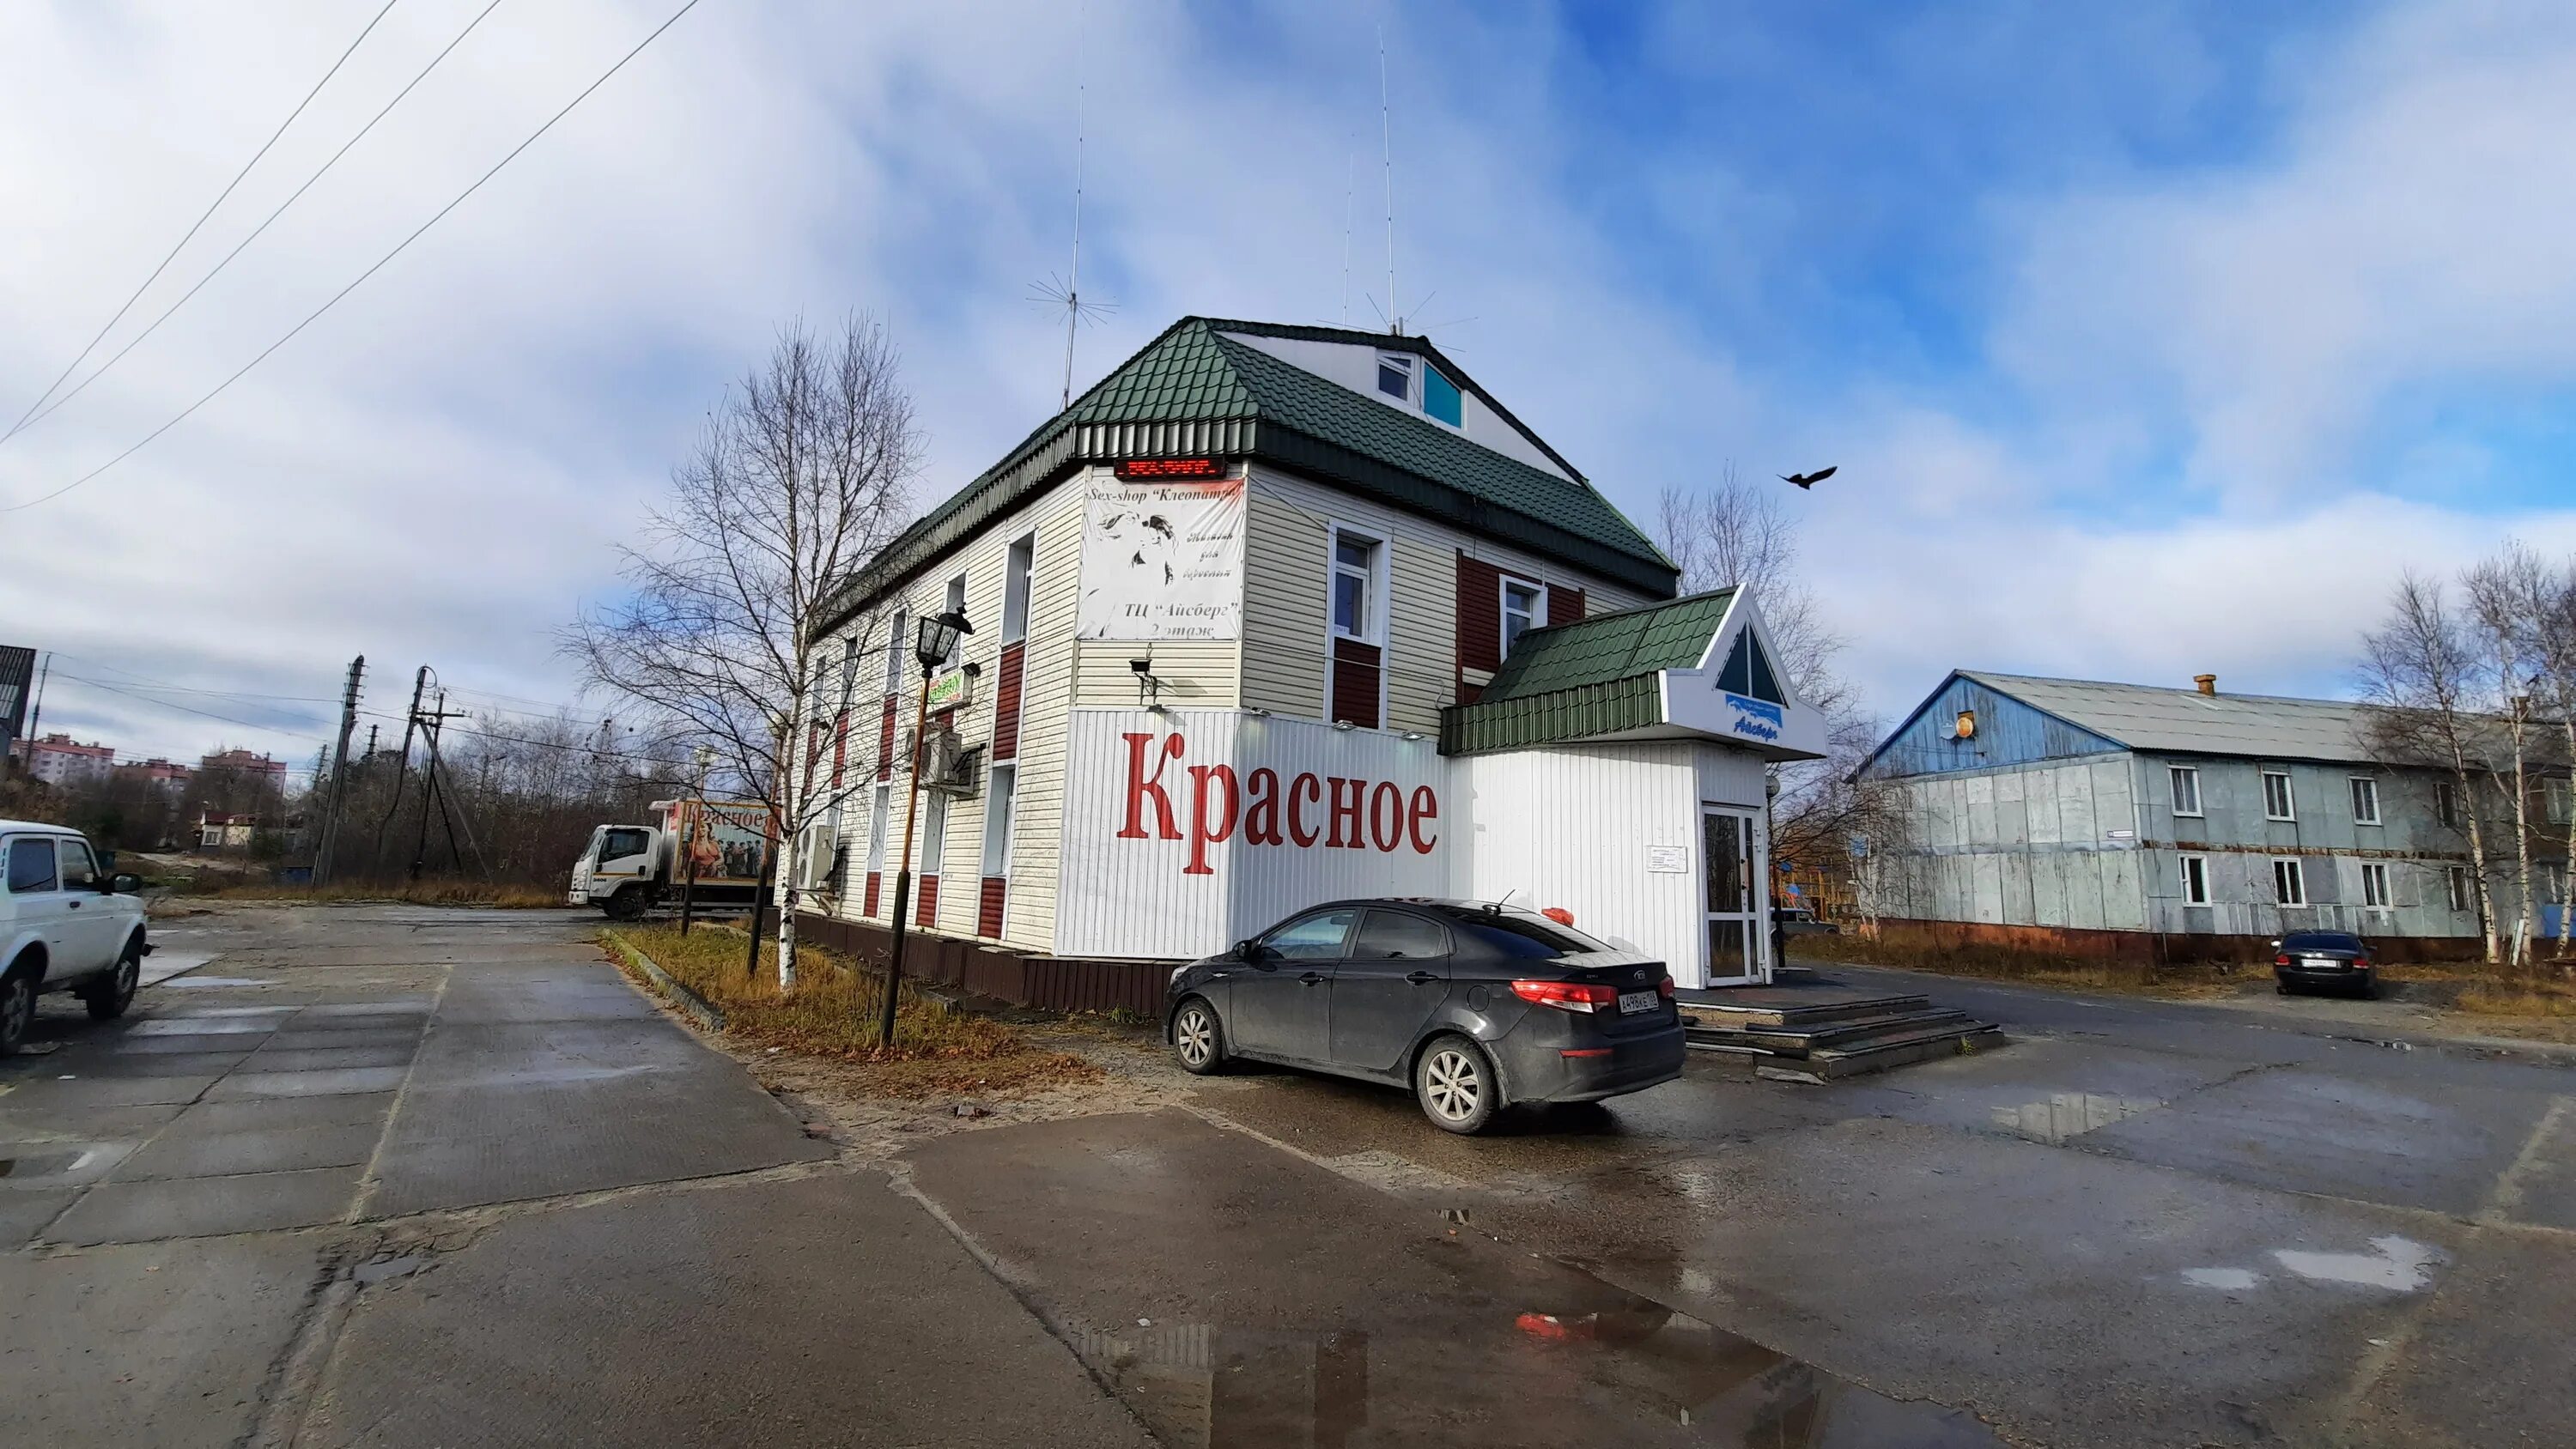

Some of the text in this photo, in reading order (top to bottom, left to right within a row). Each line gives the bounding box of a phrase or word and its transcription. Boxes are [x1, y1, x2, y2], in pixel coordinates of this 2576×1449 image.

[1089, 488, 1147, 504] Sex-shop
[1125, 603, 1149, 619] ТЦ
[1116, 732, 1437, 875] Красное
